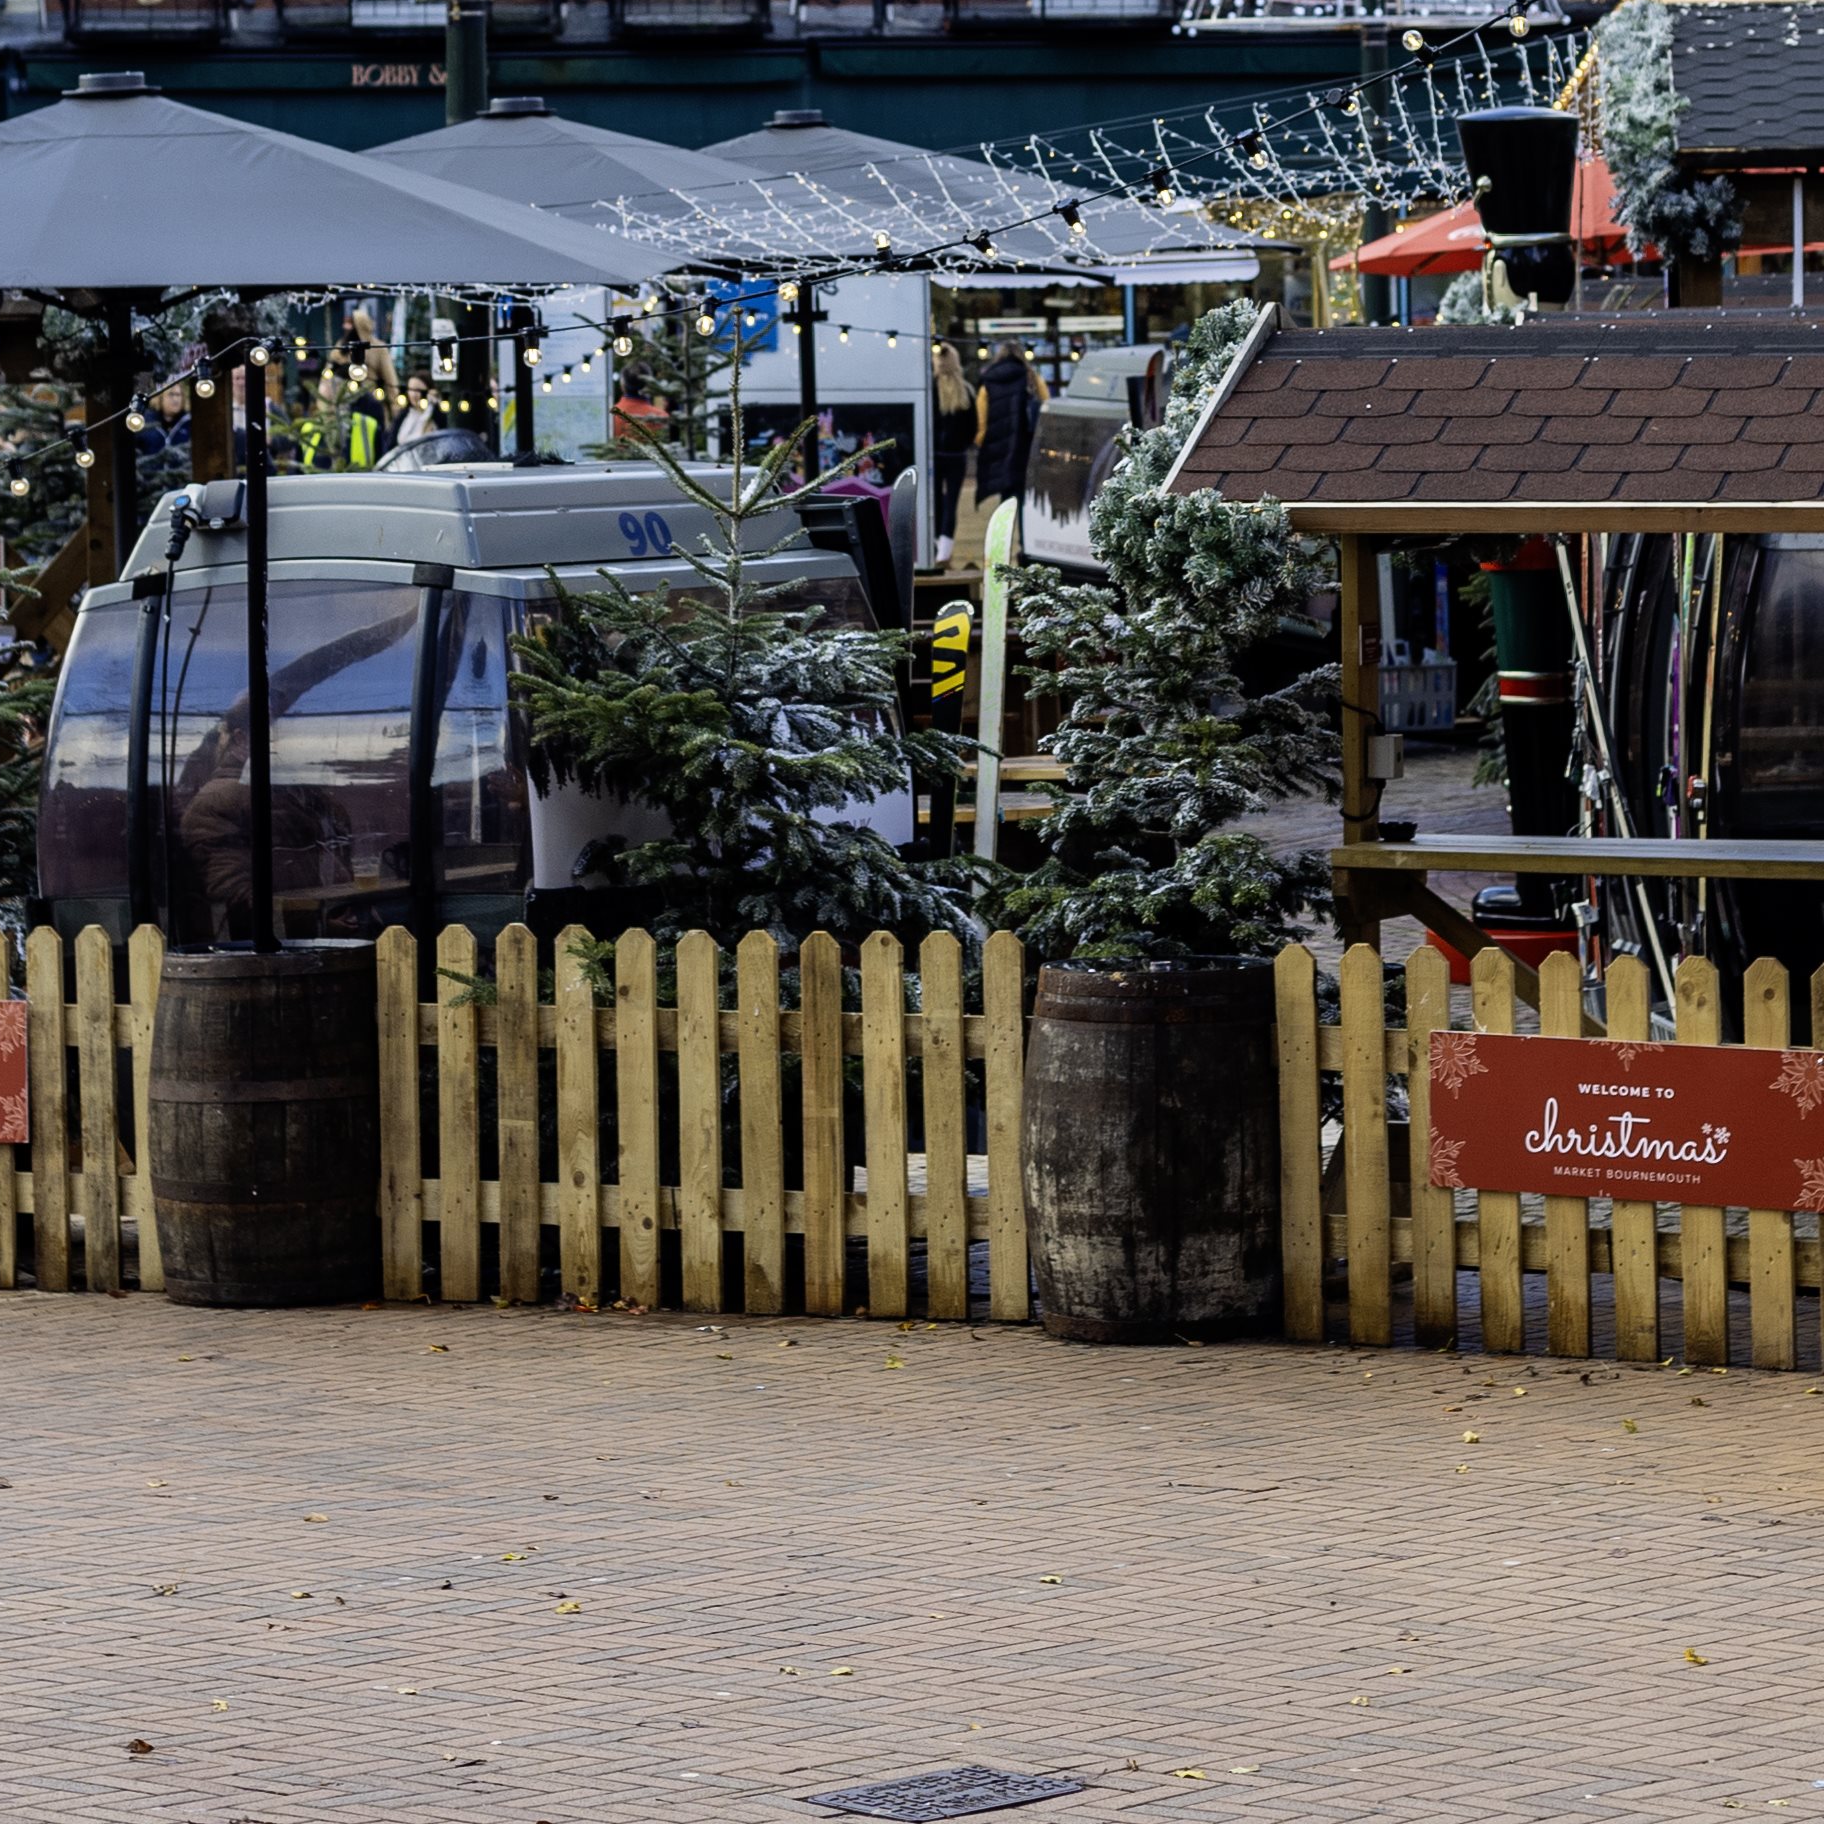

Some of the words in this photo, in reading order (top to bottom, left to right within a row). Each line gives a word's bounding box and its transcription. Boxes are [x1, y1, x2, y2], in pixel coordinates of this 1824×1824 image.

[352, 64, 421, 86] BOBBY
[618, 511, 673, 557] 90
[1578, 1083, 1651, 1098] WELCOME
[1656, 1087, 1675, 1099] TO
[1525, 1097, 1728, 1164] christmas
[1553, 1166, 1600, 1178] MARKET
[1606, 1169, 1702, 1184] BOURNEMOUTH
